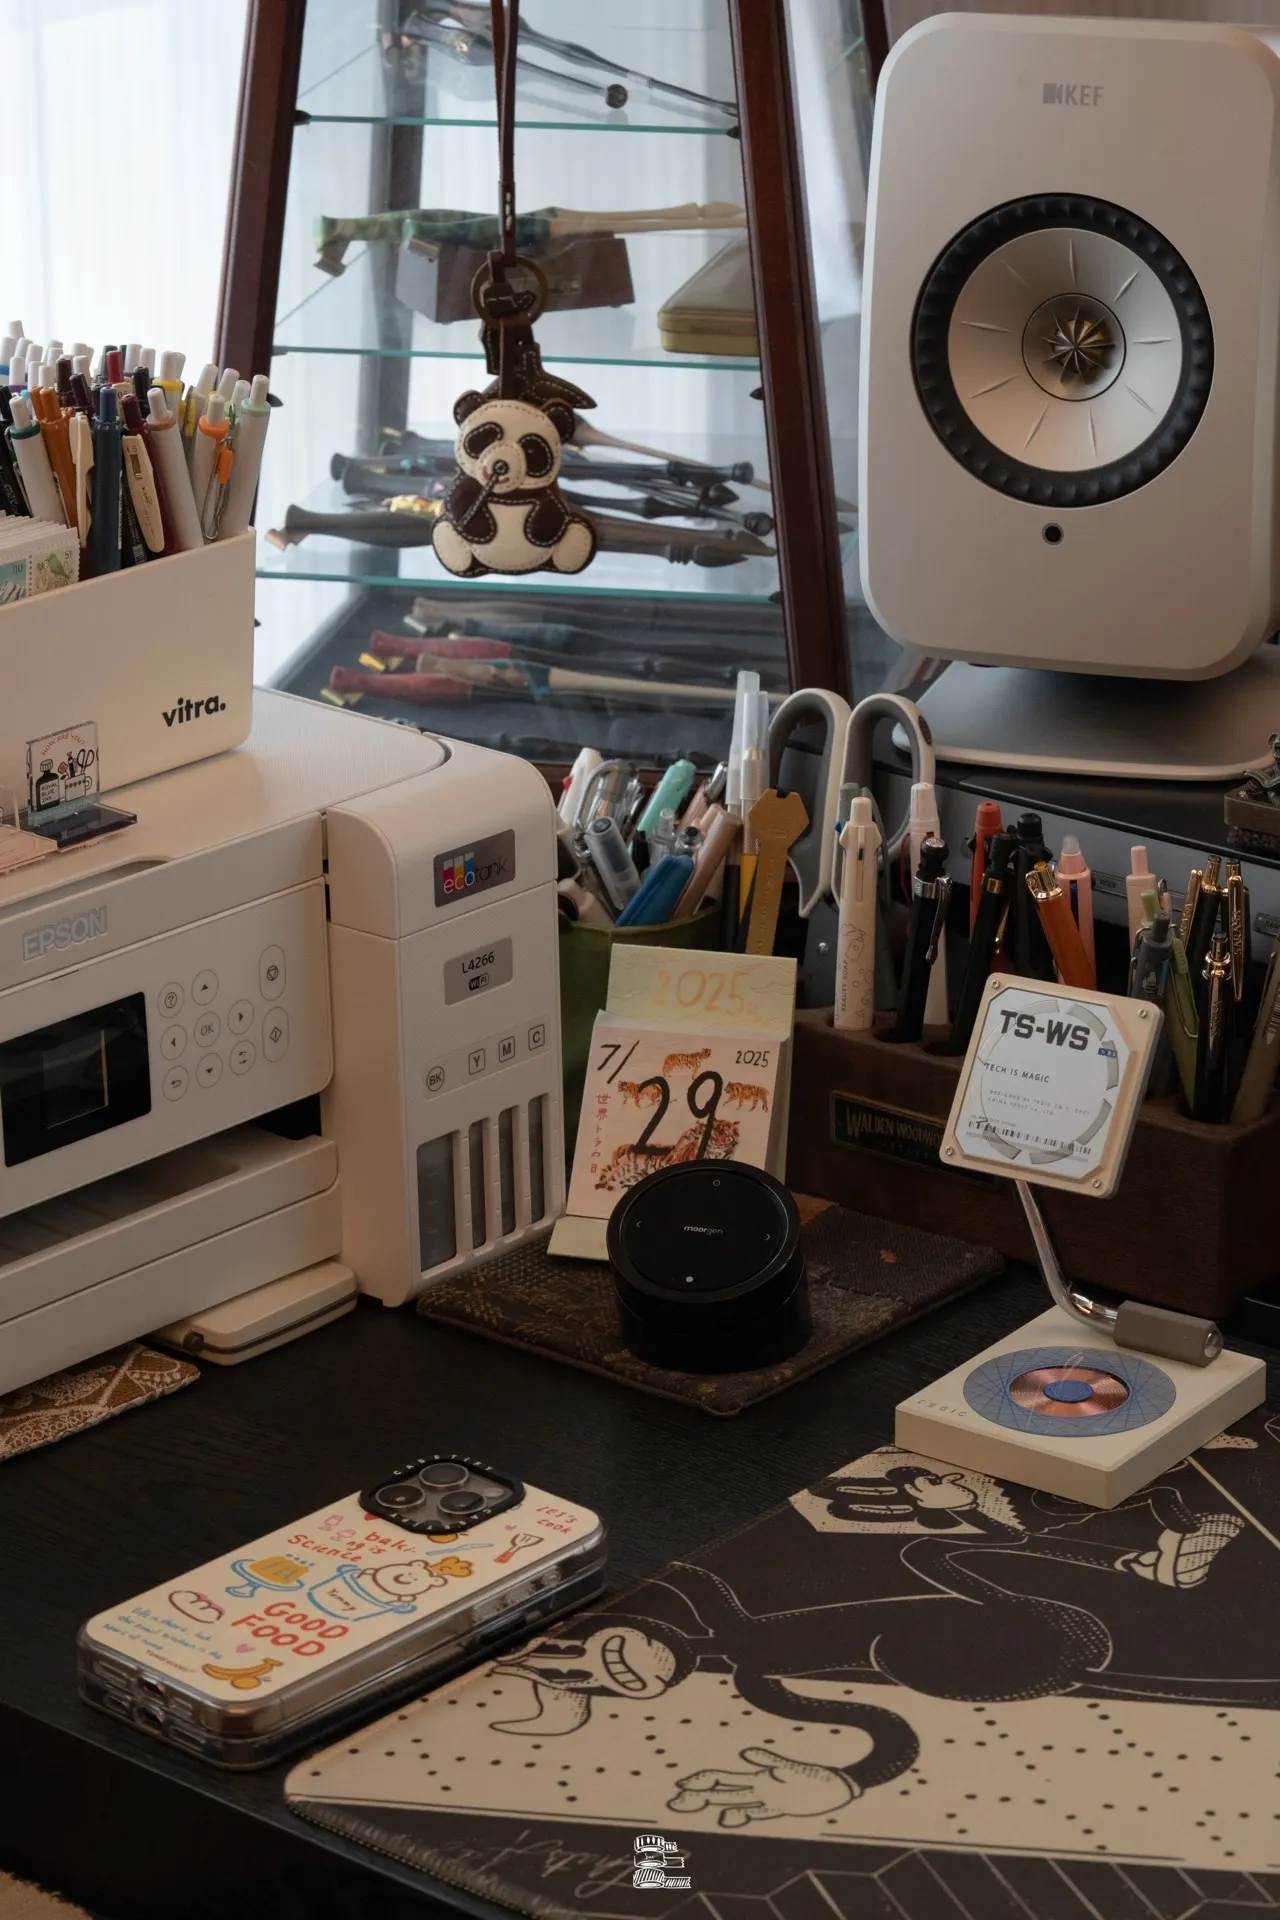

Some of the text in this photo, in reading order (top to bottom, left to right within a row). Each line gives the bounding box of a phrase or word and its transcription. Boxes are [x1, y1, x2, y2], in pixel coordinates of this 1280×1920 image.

[1065, 83, 1105, 106] KEF
[162, 695, 226, 727] vitra.
[41, 739, 55, 756] HOW
[57, 733, 69, 743] ARE
[41, 782, 58, 791] ROYAL
[41, 789, 54, 797] BLUE
[443, 856, 508, 893] ecotank
[21, 904, 107, 962] EPSON
[1231, 909, 1242, 955] SARASA
[461, 951, 495, 975] L4266
[652, 969, 749, 1017] 2025
[200, 1022, 214, 1036] OK
[532, 1031, 541, 1043] C
[1000, 1009, 1090, 1051] TS-WS
[473, 1055, 481, 1068] Y
[503, 1044, 512, 1057] M
[735, 1050, 771, 1068] 2025
[429, 1071, 442, 1086] BK
[986, 1062, 1050, 1083] TECH IS MAGIC
[629, 1070, 723, 1161] 29
[846, 1107, 894, 1138] WALDEN
[896, 1121, 942, 1149] WOODWO
[683, 1224, 724, 1236] moorgen
[393, 1454, 494, 1476] CASETIFY
[326, 1588, 357, 1612] Yummy
[263, 1601, 350, 1639] GOOD
[231, 1613, 325, 1657] FOOD
